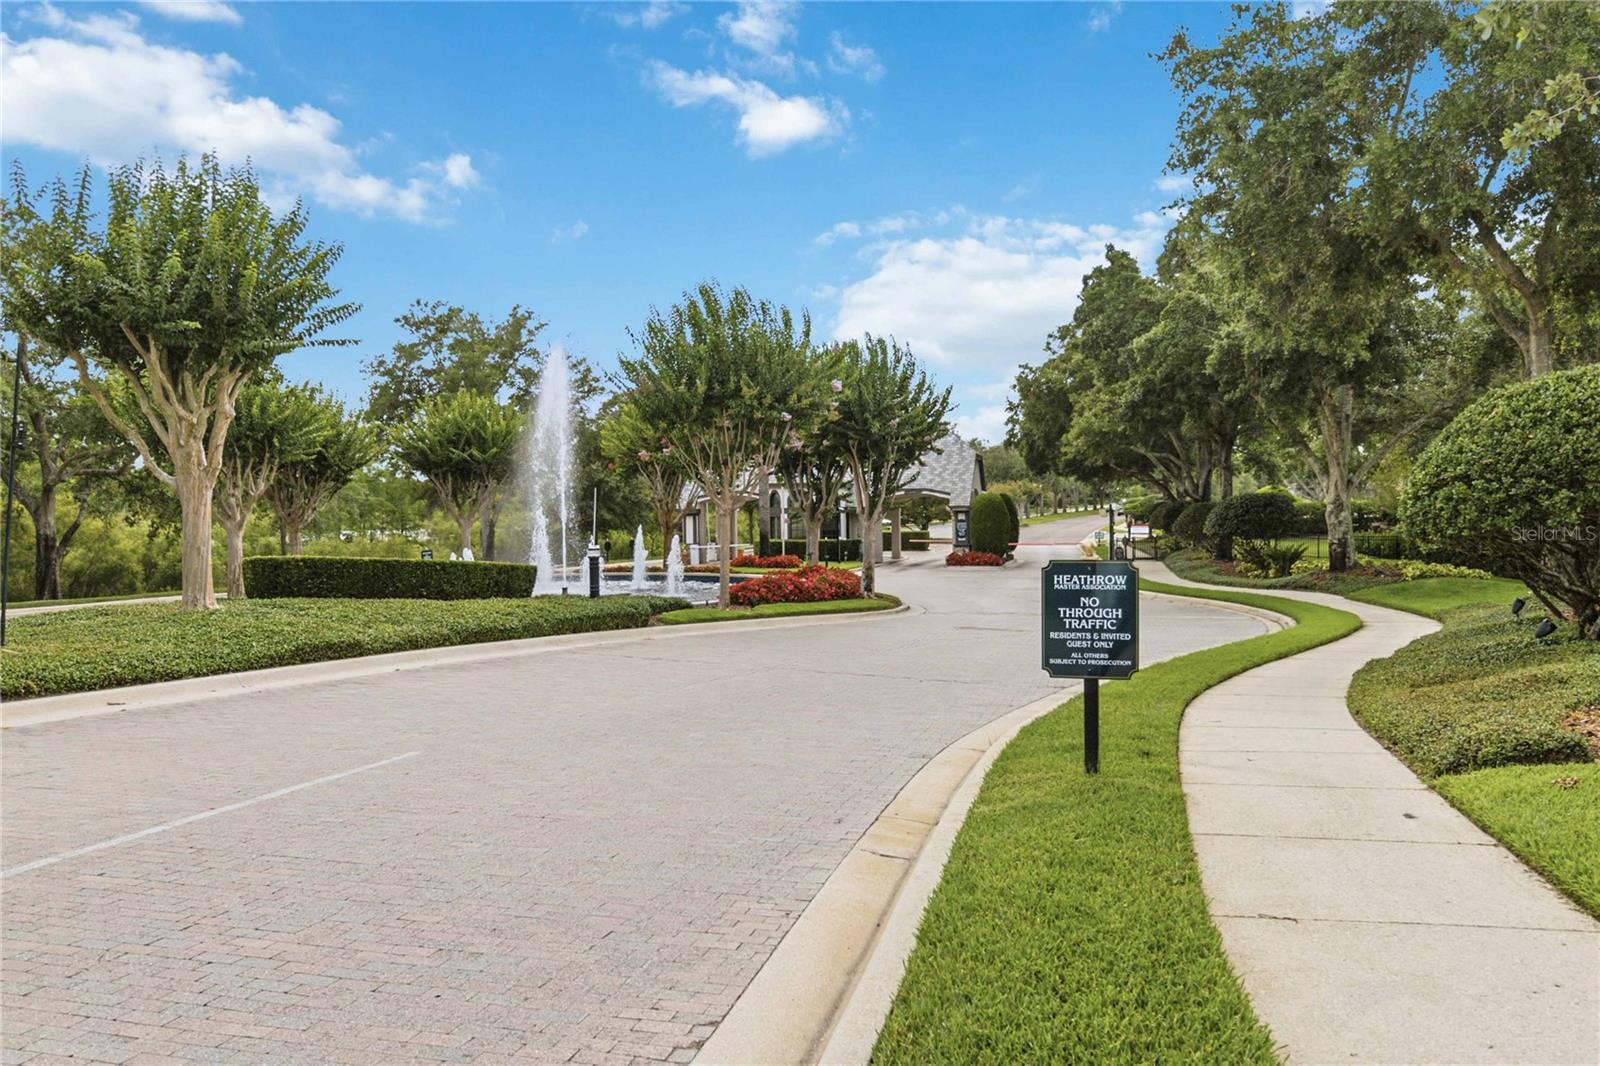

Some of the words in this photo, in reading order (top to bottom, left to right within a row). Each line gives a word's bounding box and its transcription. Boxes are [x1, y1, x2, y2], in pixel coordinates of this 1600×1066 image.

[1053, 575, 1127, 584] HEATHROW
[1080, 597, 1099, 607] NO
[1058, 608, 1122, 618] THROUGH
[1063, 619, 1117, 629] TRAFFIC
[1049, 632, 1091, 640] RESIDENTS
[1093, 632, 1099, 640] &
[1066, 640, 1092, 648] GUEST
